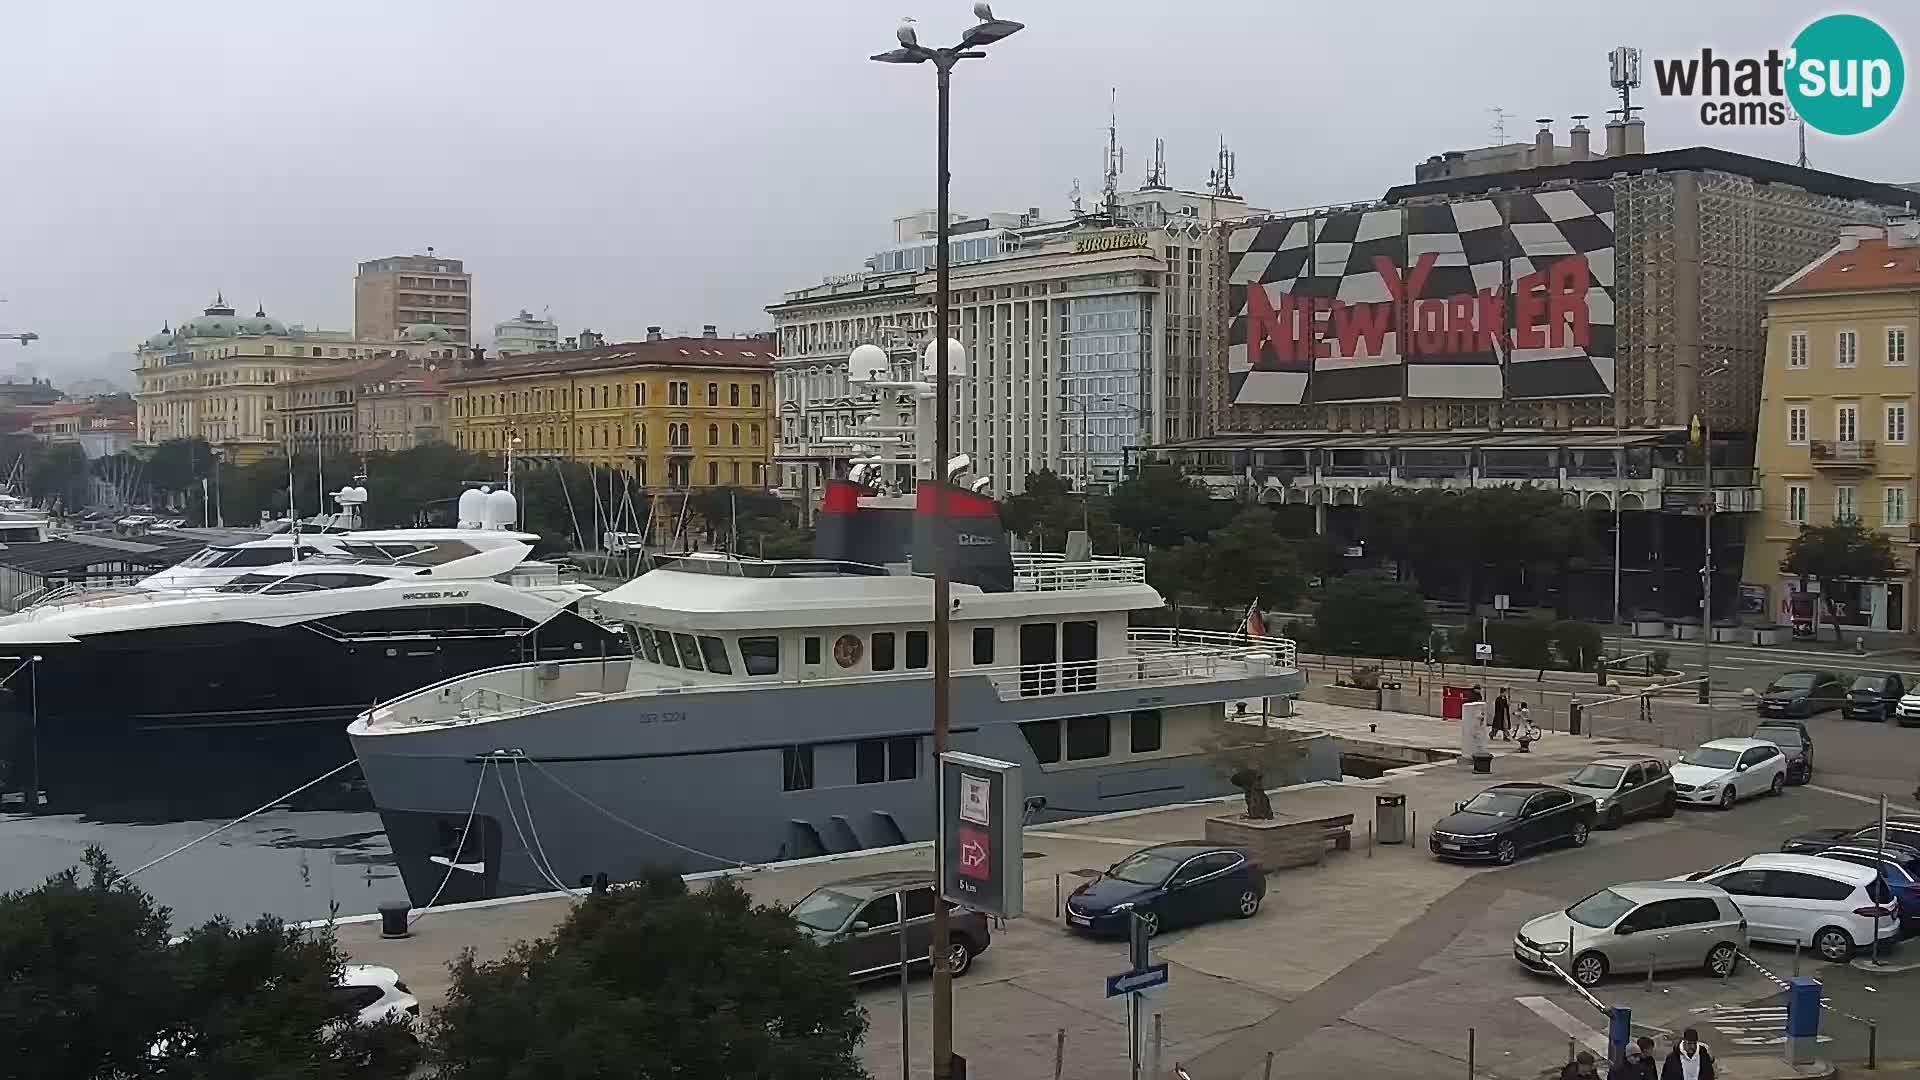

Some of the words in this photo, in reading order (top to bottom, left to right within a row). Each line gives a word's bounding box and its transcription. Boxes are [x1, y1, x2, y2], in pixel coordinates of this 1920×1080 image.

[1076, 231, 1148, 253] EUROHERC
[1246, 279, 1391, 364] NEW
[1374, 251, 1591, 354] YORKER
[402, 591, 441, 600] WICKED
[443, 590, 469, 598] PLAY
